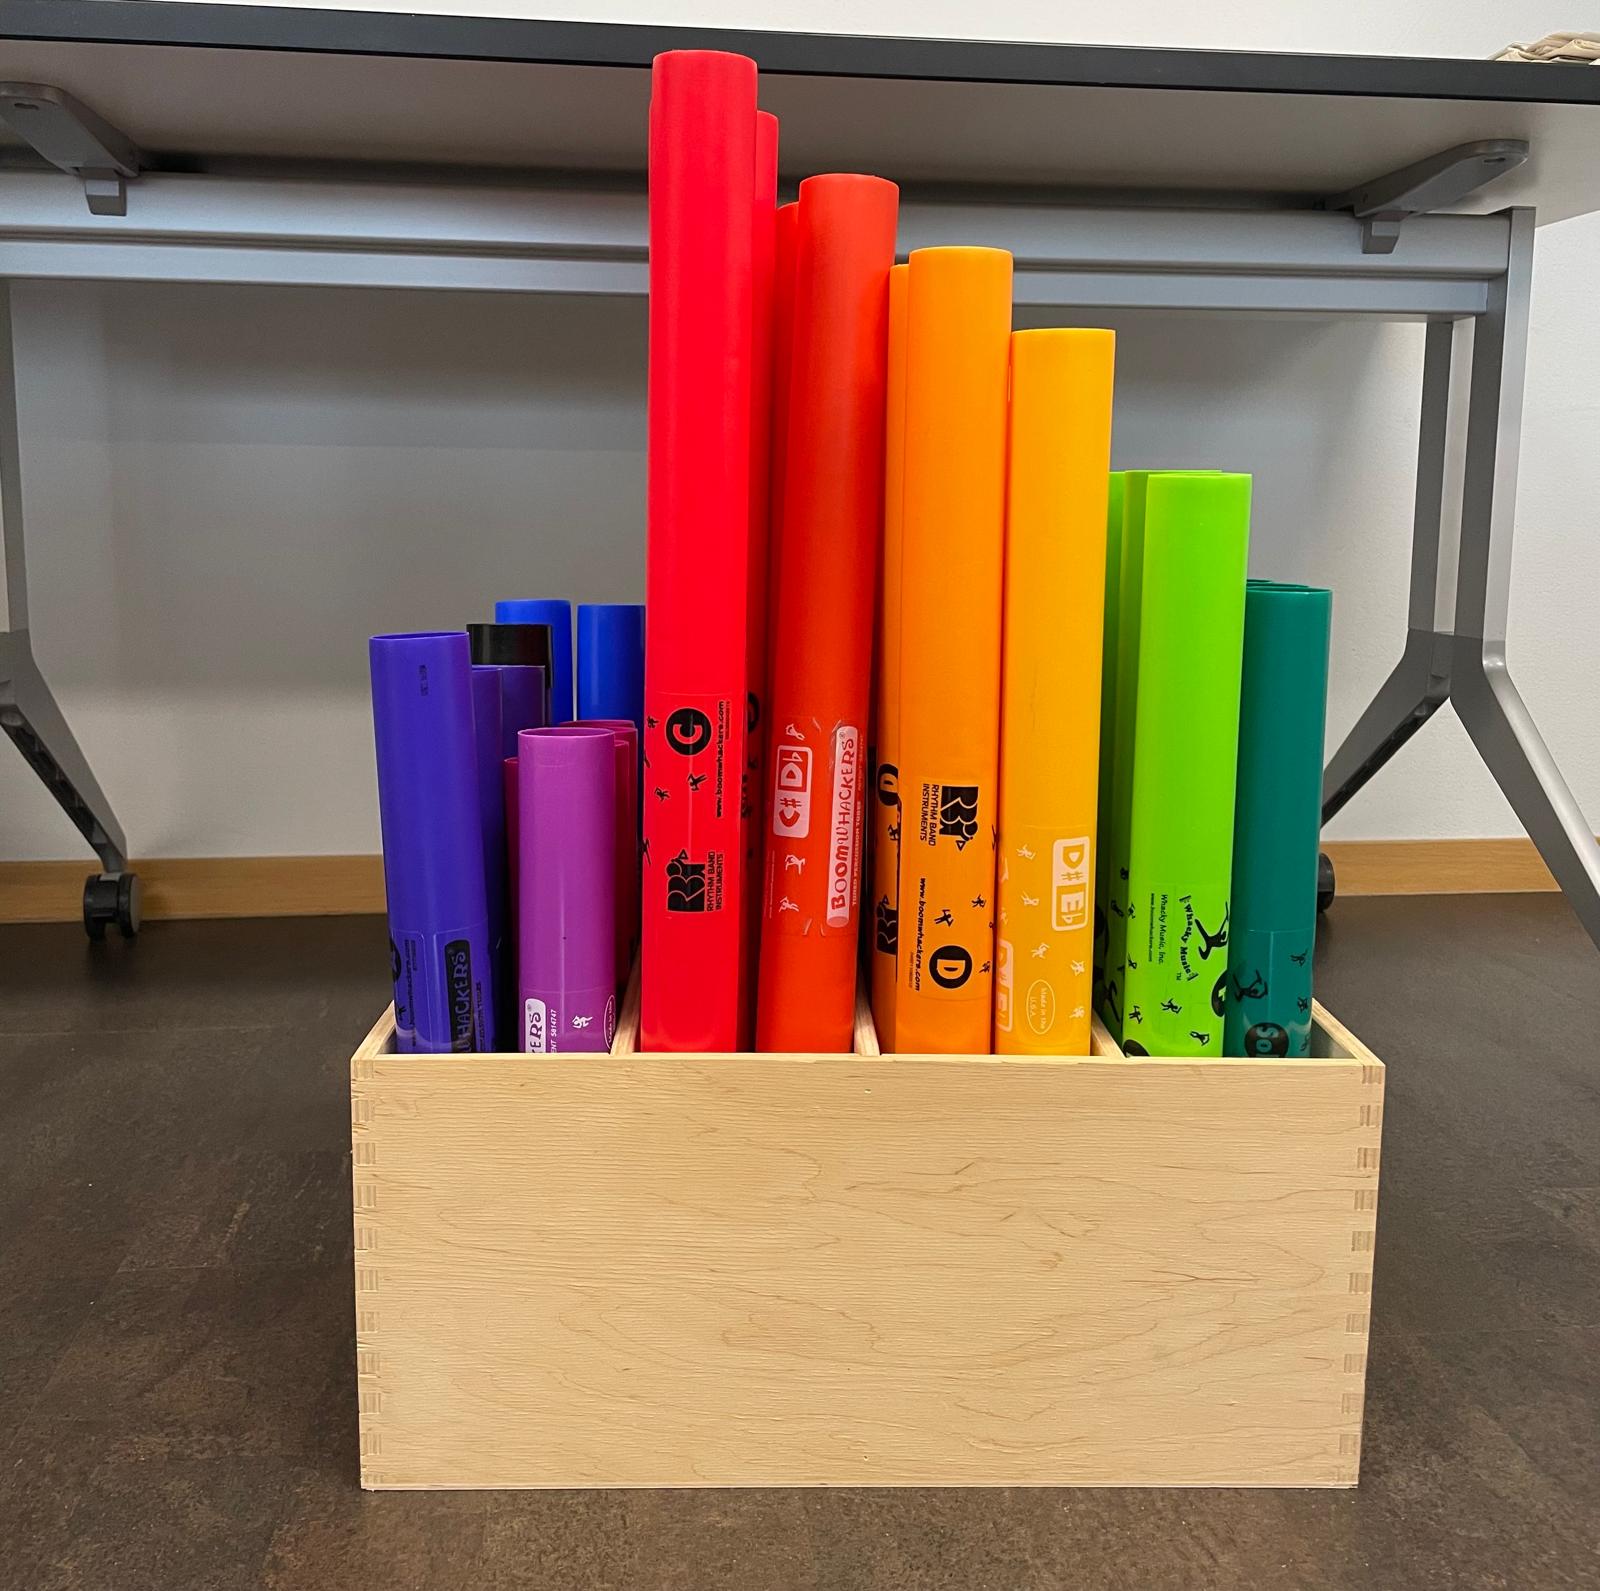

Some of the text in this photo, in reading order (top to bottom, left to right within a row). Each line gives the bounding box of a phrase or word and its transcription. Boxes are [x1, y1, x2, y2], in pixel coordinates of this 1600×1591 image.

[779, 797, 802, 828] C#
[919, 783, 930, 842] INSTRUMENTS
[928, 784, 940, 847] RHYTHM BAND
[706, 851, 715, 912] RHYTHM BAND
[715, 853, 724, 910] INSTRUMENTS
[1159, 894, 1169, 923] Whacky
[1181, 903, 1194, 944] Whacky
[914, 877, 927, 992] www.boomwhackers.com
[1180, 946, 1192, 974] Music
[528, 1012, 543, 1053] ERS
